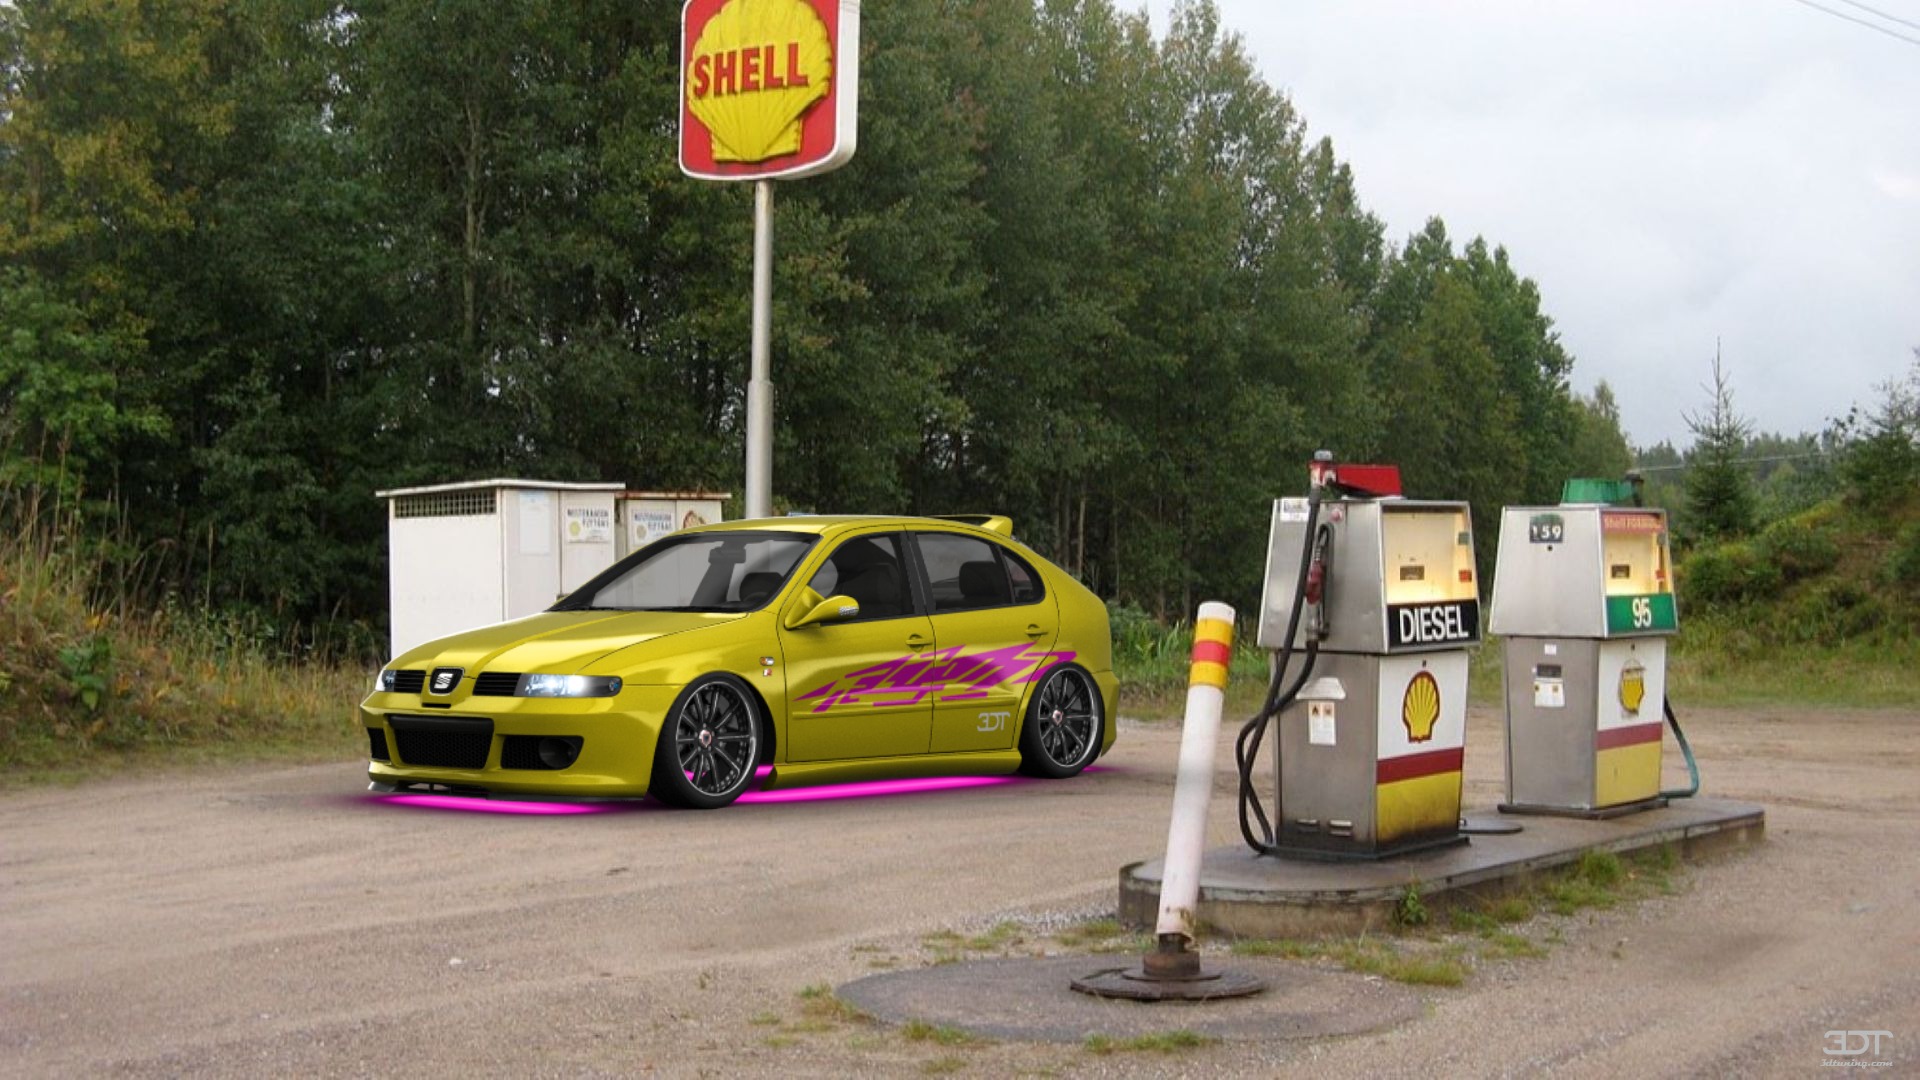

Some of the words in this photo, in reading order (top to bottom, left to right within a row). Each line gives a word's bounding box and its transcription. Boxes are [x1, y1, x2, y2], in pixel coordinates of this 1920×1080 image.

[693, 42, 808, 100] SHELL
[1399, 604, 1469, 643] DIESEL
[1632, 597, 1652, 629] 95
[976, 711, 1011, 732] 3DT
